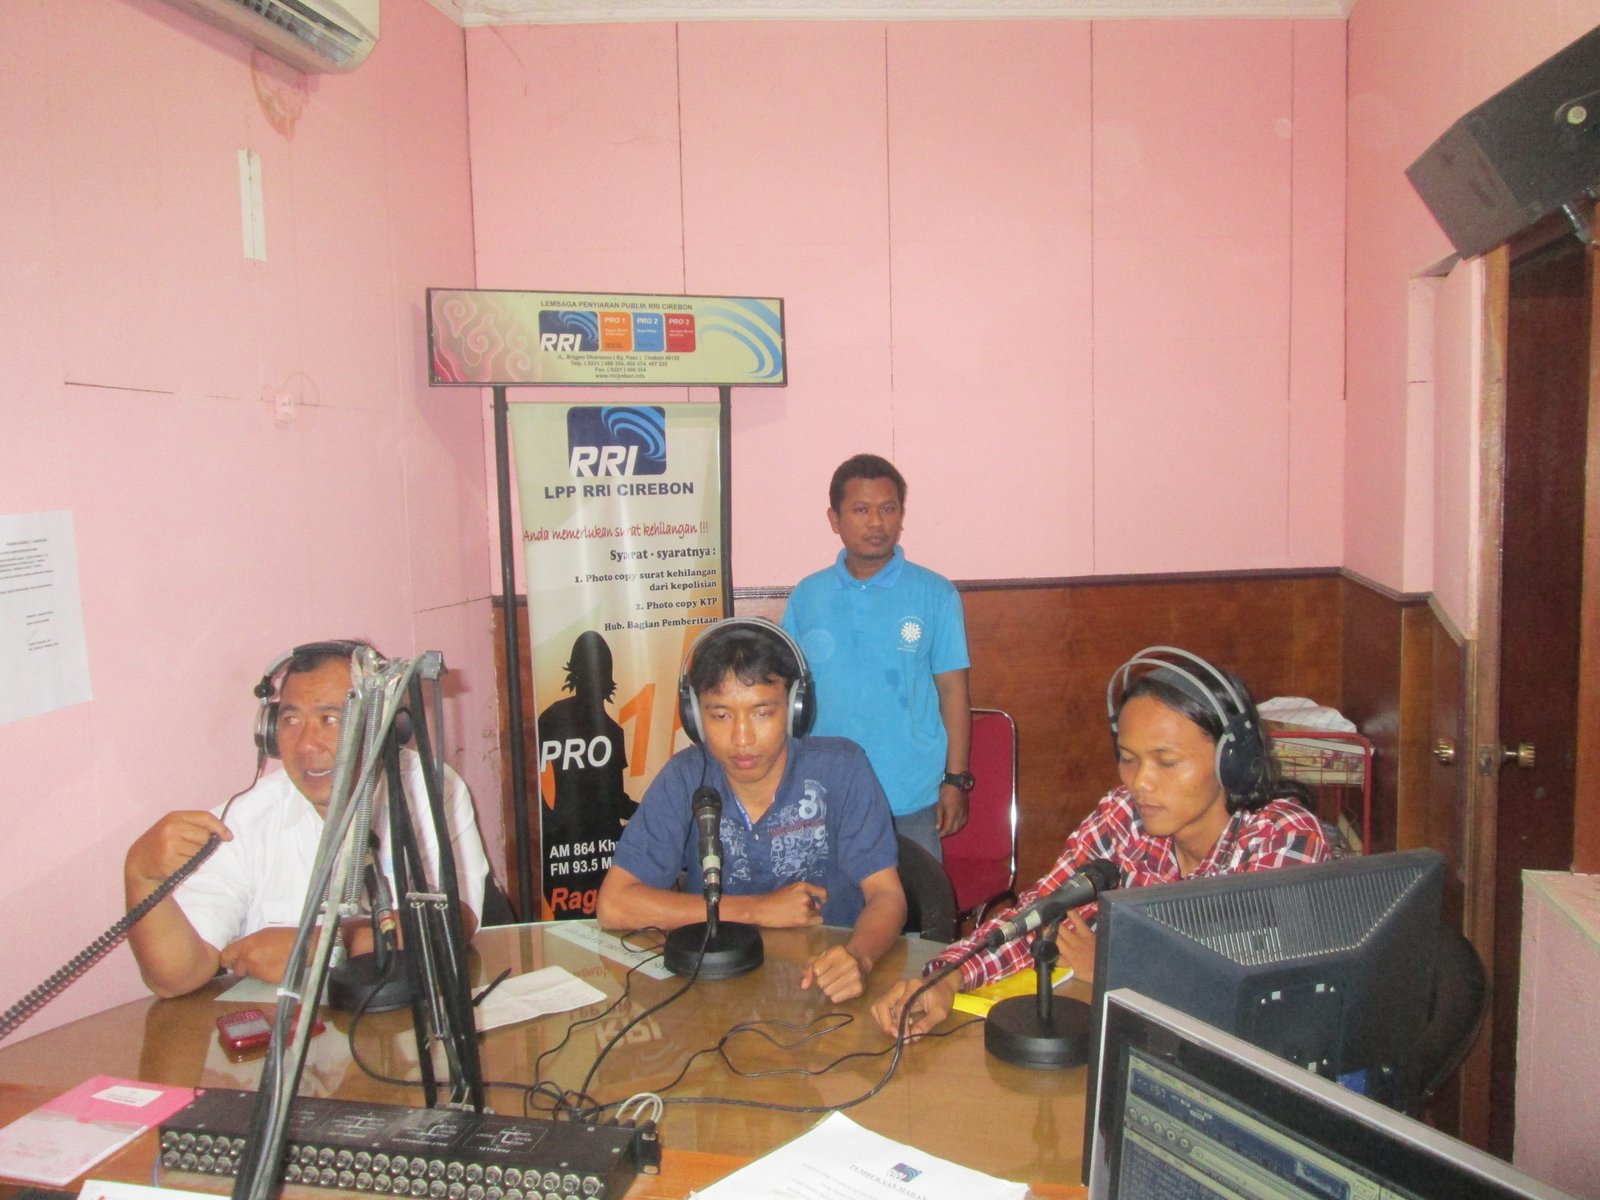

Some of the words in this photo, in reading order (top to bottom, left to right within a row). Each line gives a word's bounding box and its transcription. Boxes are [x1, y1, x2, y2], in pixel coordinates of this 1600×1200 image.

[540, 333, 582, 352] RRI
[569, 446, 639, 477] RRI
[544, 486, 576, 499] LPP
[583, 484, 610, 497] RRI
[617, 482, 694, 496] CIREBON
[523, 527, 549, 541] Anda
[552, 525, 613, 540] memerlukan
[643, 522, 697, 538] kehilangan
[610, 549, 648, 562] Syarat
[640, 571, 664, 579] surat
[667, 569, 716, 577] kehilangan
[649, 583, 668, 591] dari
[671, 581, 717, 590] kepolisian
[700, 598, 717, 606] KTP
[605, 622, 624, 631] Hub.
[627, 620, 659, 630] Bagian
[662, 617, 718, 627] Pemberitaan
[540, 735, 612, 773] PRO
[619, 683, 656, 777] 1
[549, 844, 570, 858] AM
[574, 841, 595, 856] 864
[598, 839, 618, 852] Kh
[550, 862, 569, 876] FM
[572, 859, 598, 873] 93.5
